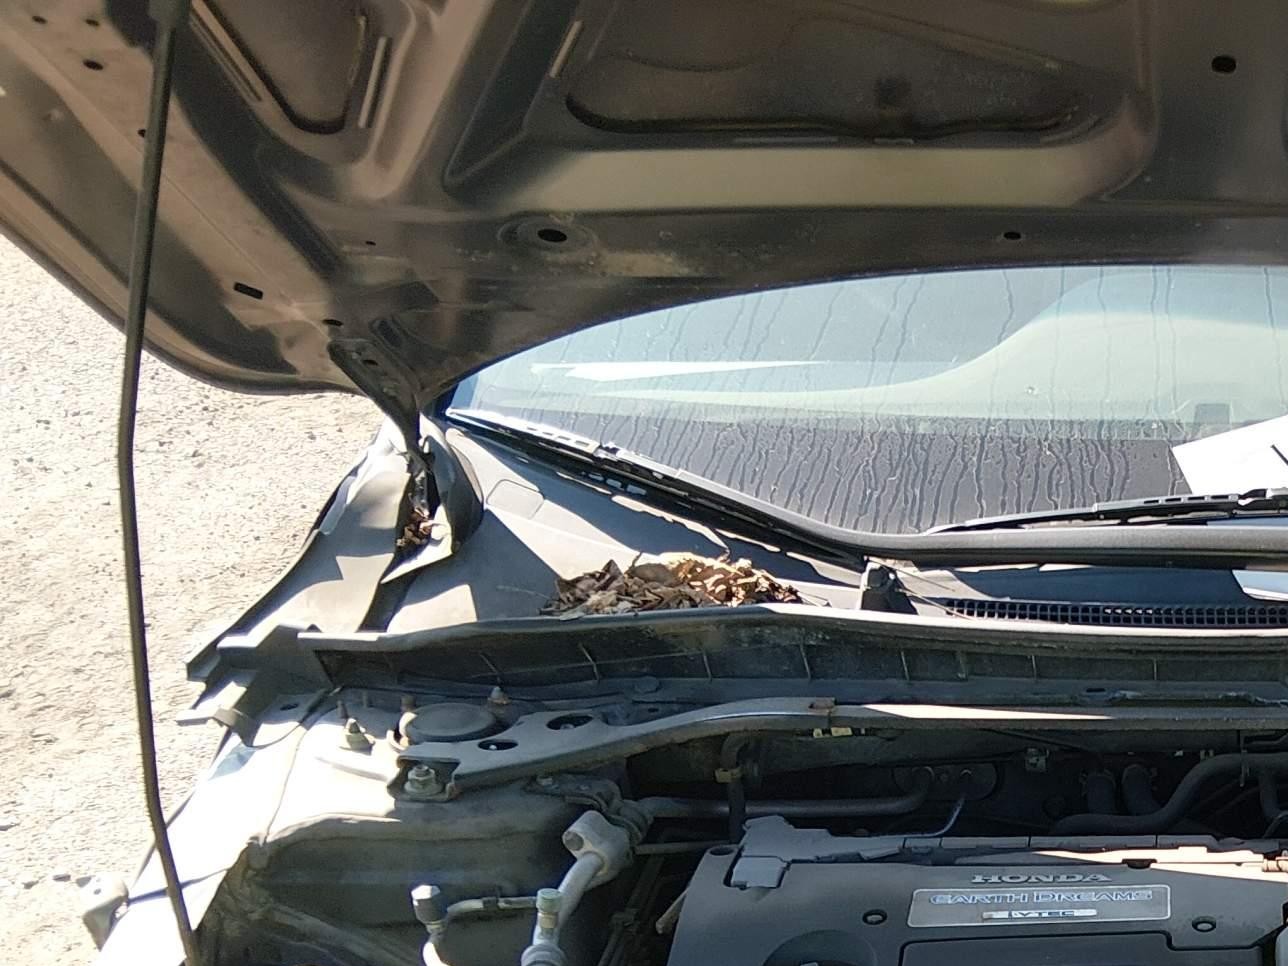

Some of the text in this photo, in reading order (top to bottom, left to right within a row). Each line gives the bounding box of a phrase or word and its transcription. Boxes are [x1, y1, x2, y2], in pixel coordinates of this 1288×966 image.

[971, 874, 1112, 884] HONDA
[930, 889, 1153, 905] EARTH DREAMS
